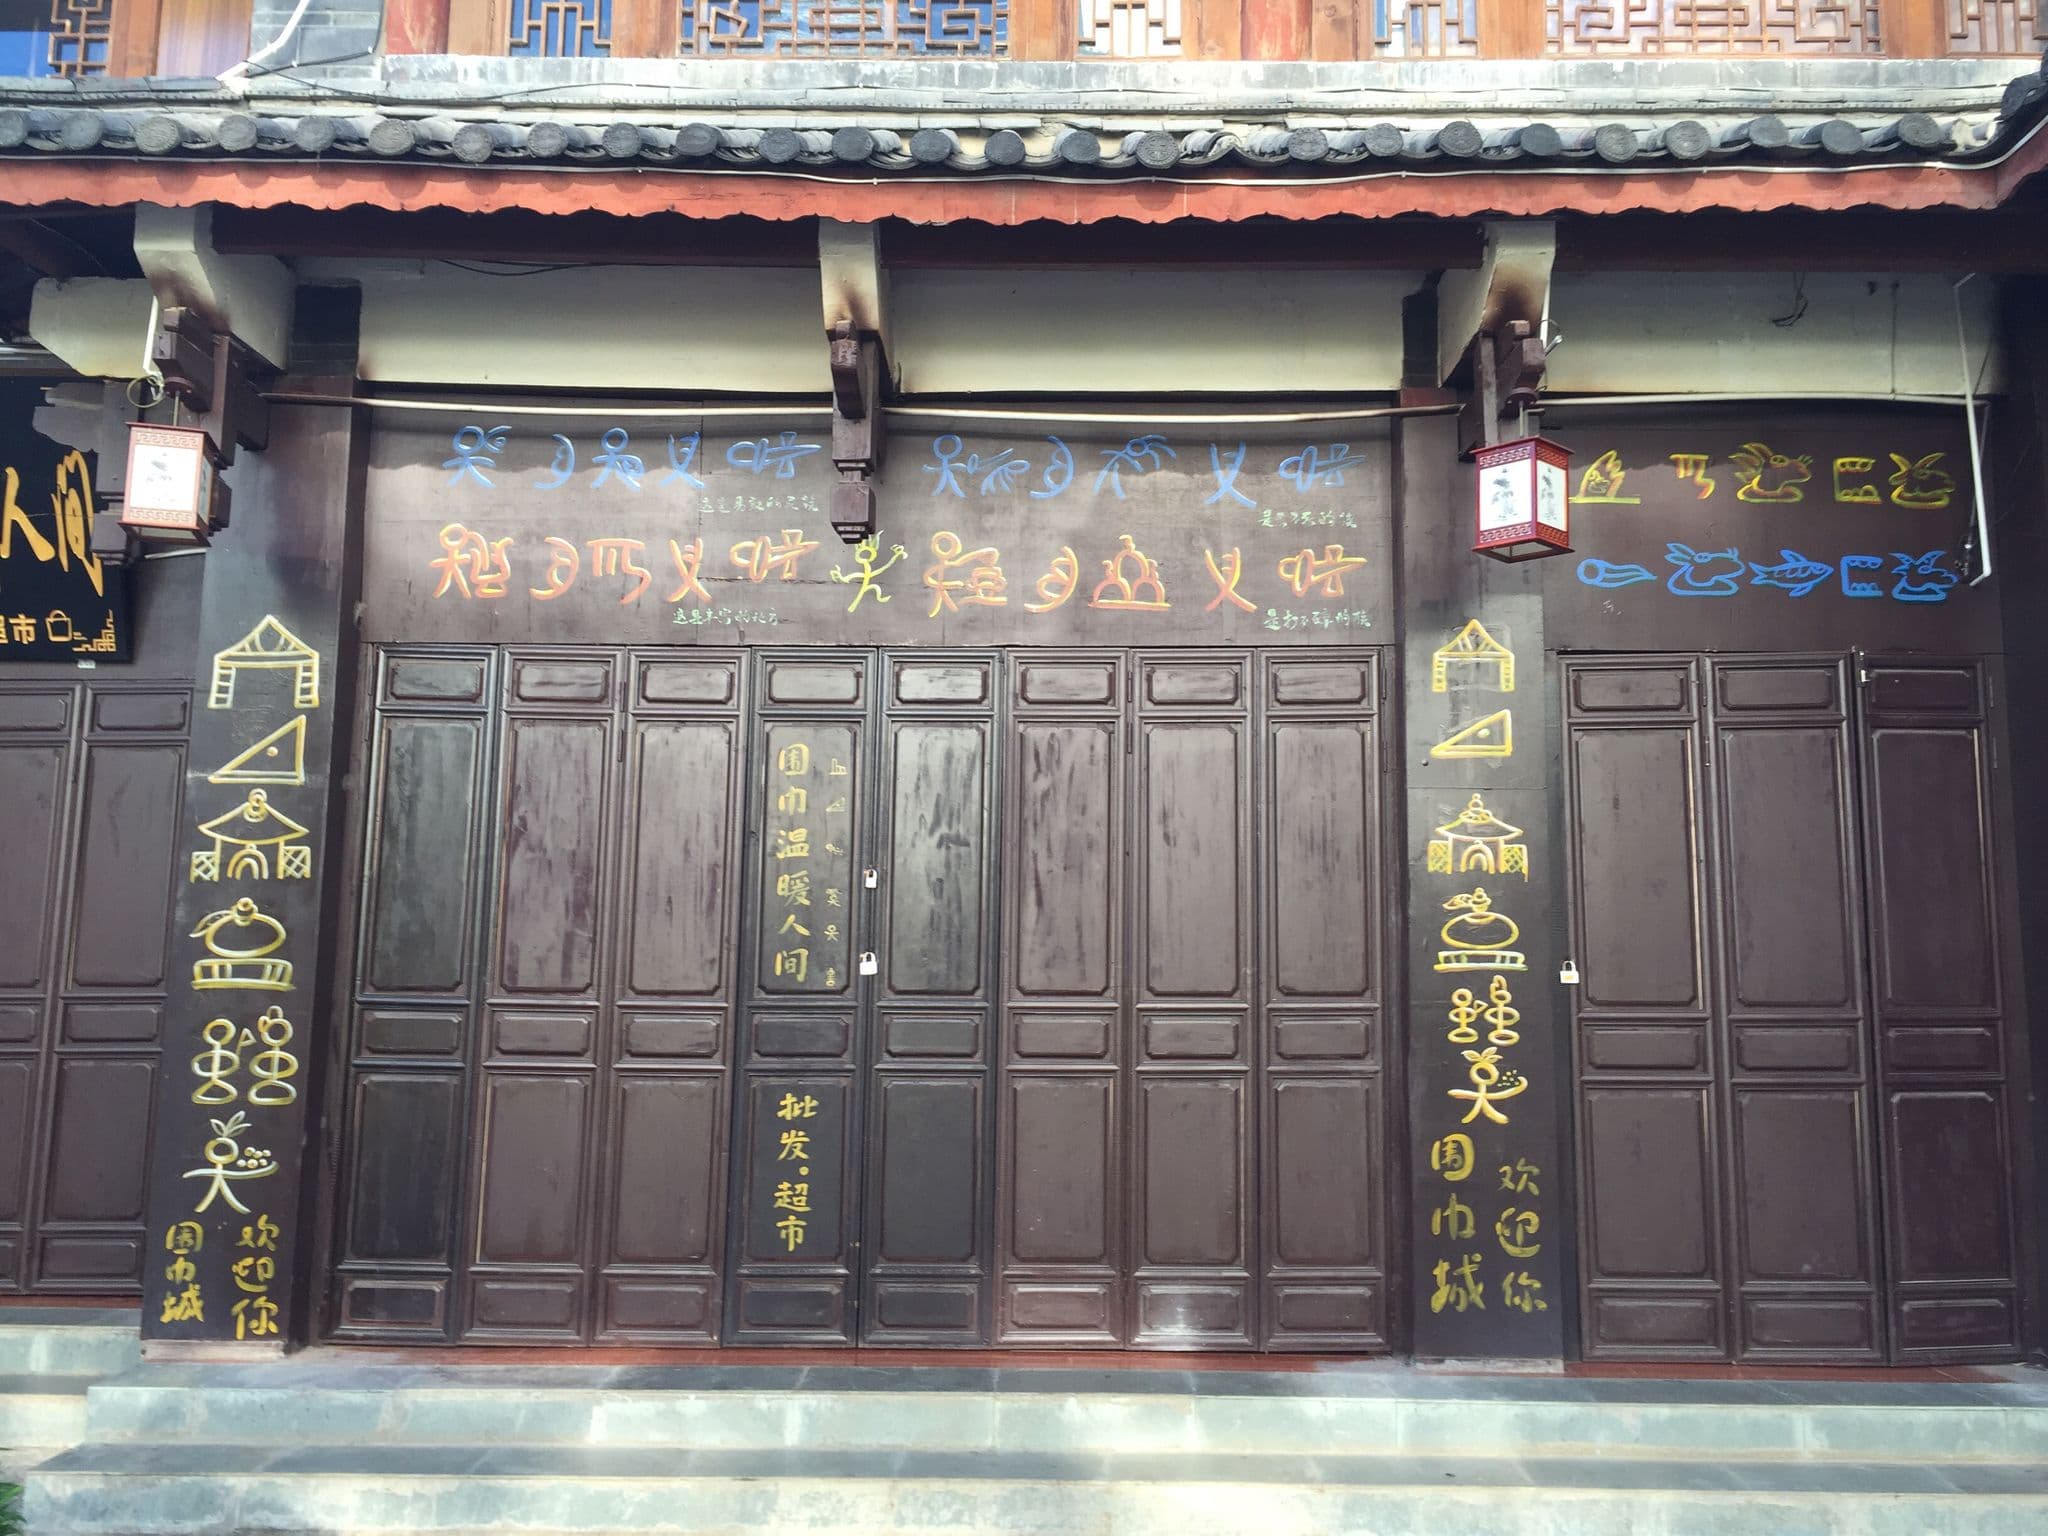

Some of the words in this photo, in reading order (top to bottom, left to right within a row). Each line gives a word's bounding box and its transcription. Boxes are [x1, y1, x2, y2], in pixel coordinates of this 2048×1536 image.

[0, 610, 37, 645] 市
[231, 1213, 280, 1341] 欢迎你
[1495, 1156, 1548, 1313] 欢迎你
